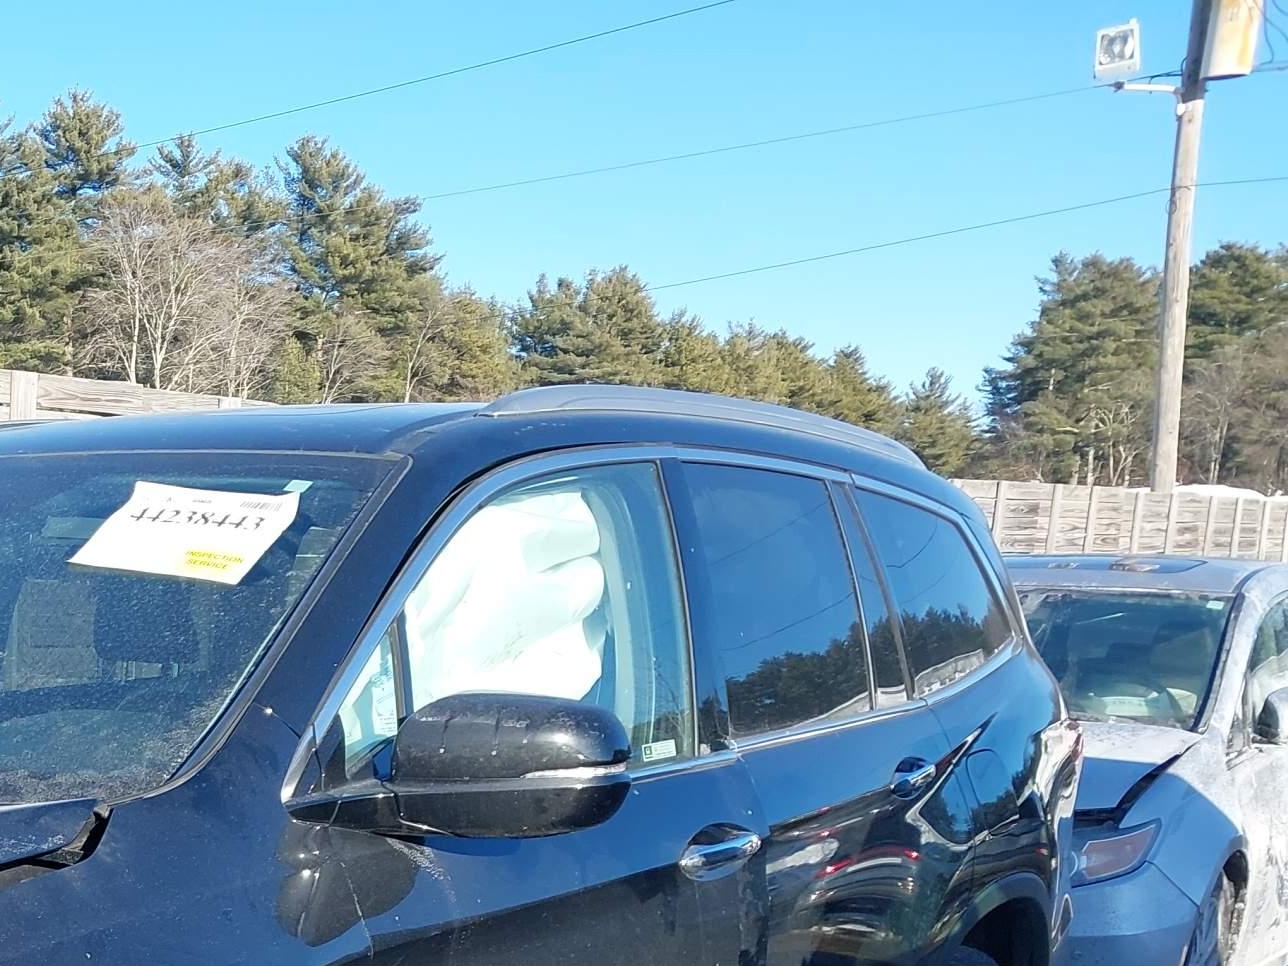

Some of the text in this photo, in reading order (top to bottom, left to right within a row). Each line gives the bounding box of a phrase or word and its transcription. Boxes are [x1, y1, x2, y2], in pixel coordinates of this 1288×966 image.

[130, 507, 265, 530] 44238443
[185, 550, 243, 563] INSPECTION
[185, 559, 228, 570] SERVICE
